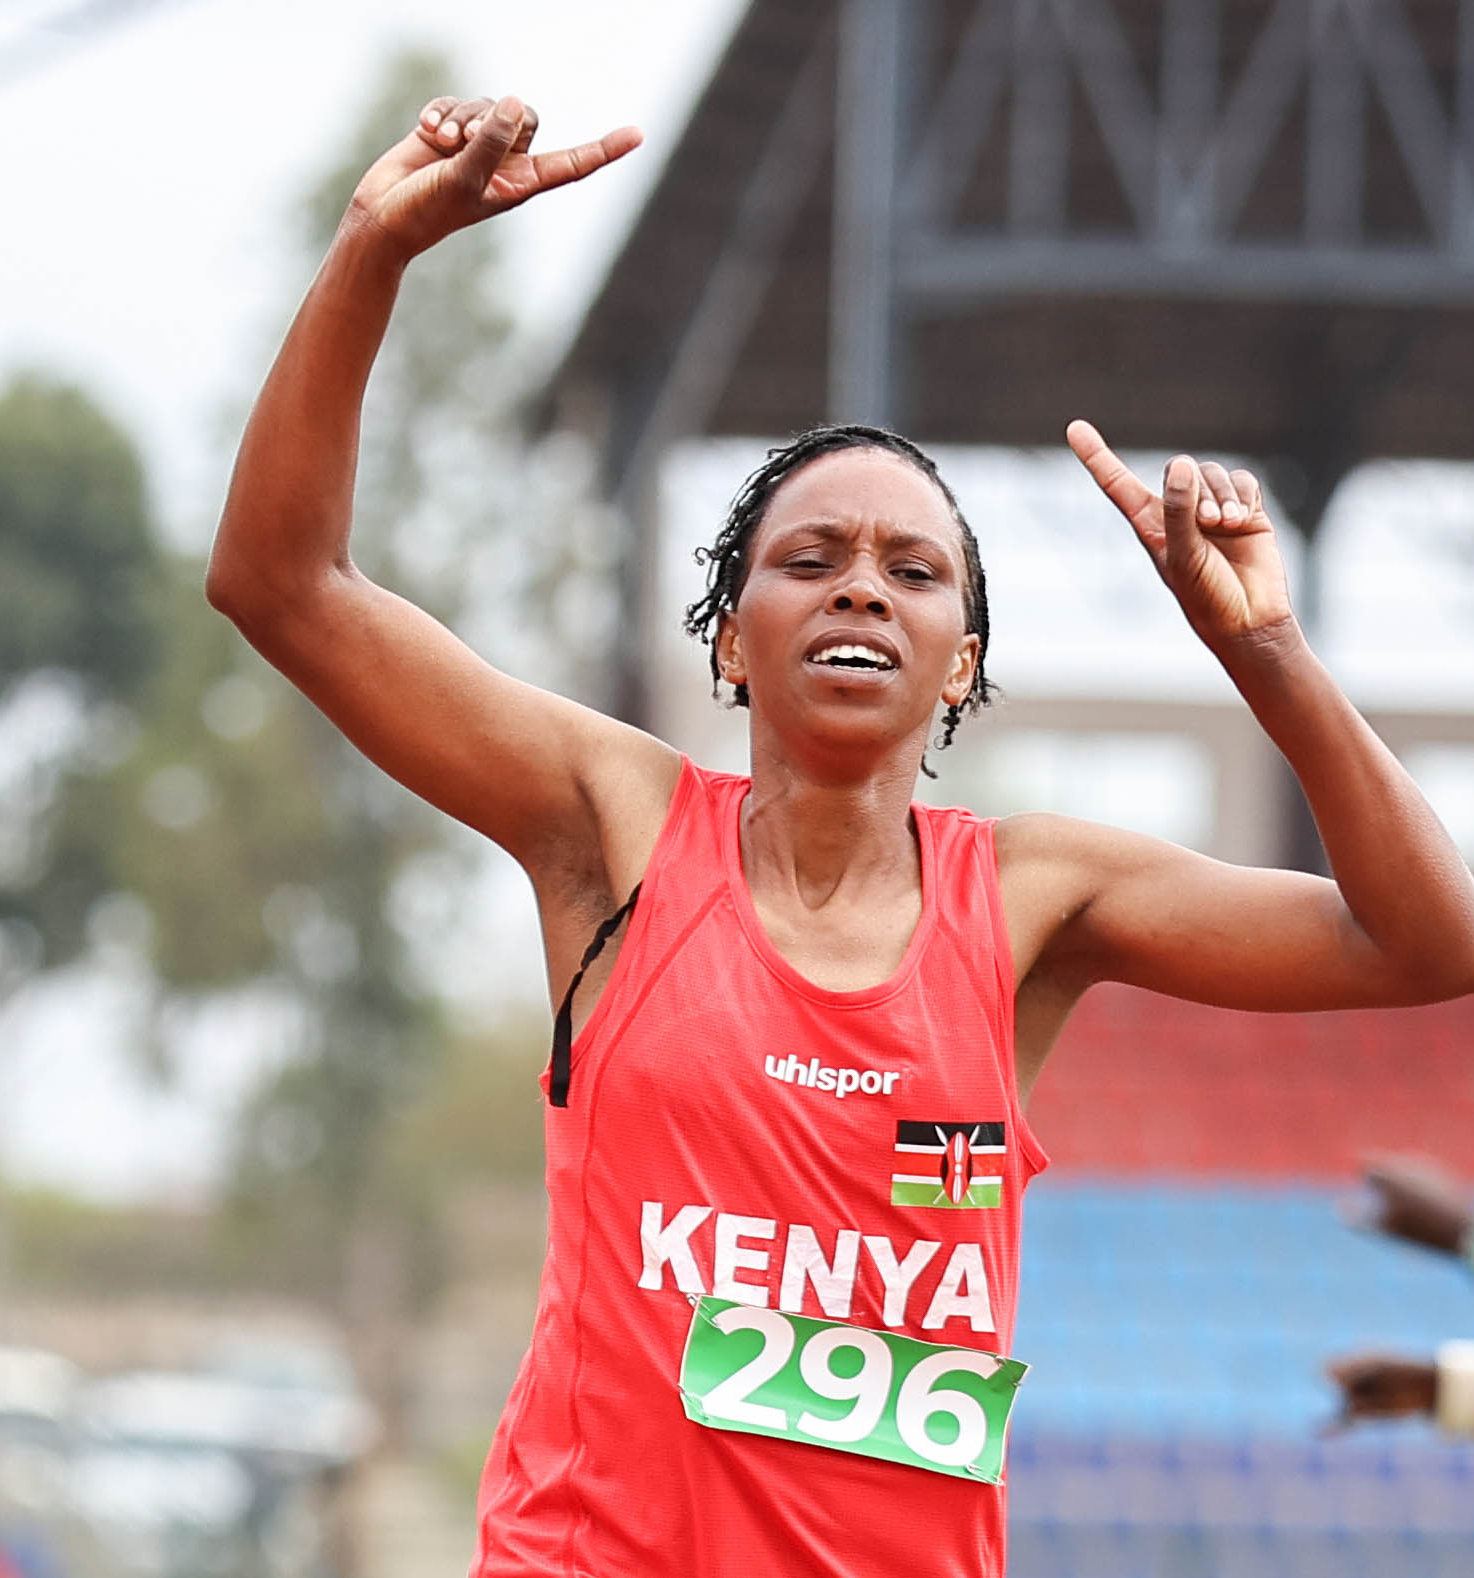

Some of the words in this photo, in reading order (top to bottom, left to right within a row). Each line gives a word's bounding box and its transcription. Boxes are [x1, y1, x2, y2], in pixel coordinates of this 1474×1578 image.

[765, 1054, 900, 1098] uhlspor
[637, 1201, 996, 1333] KENYA
[701, 1306, 1003, 1467] 296
